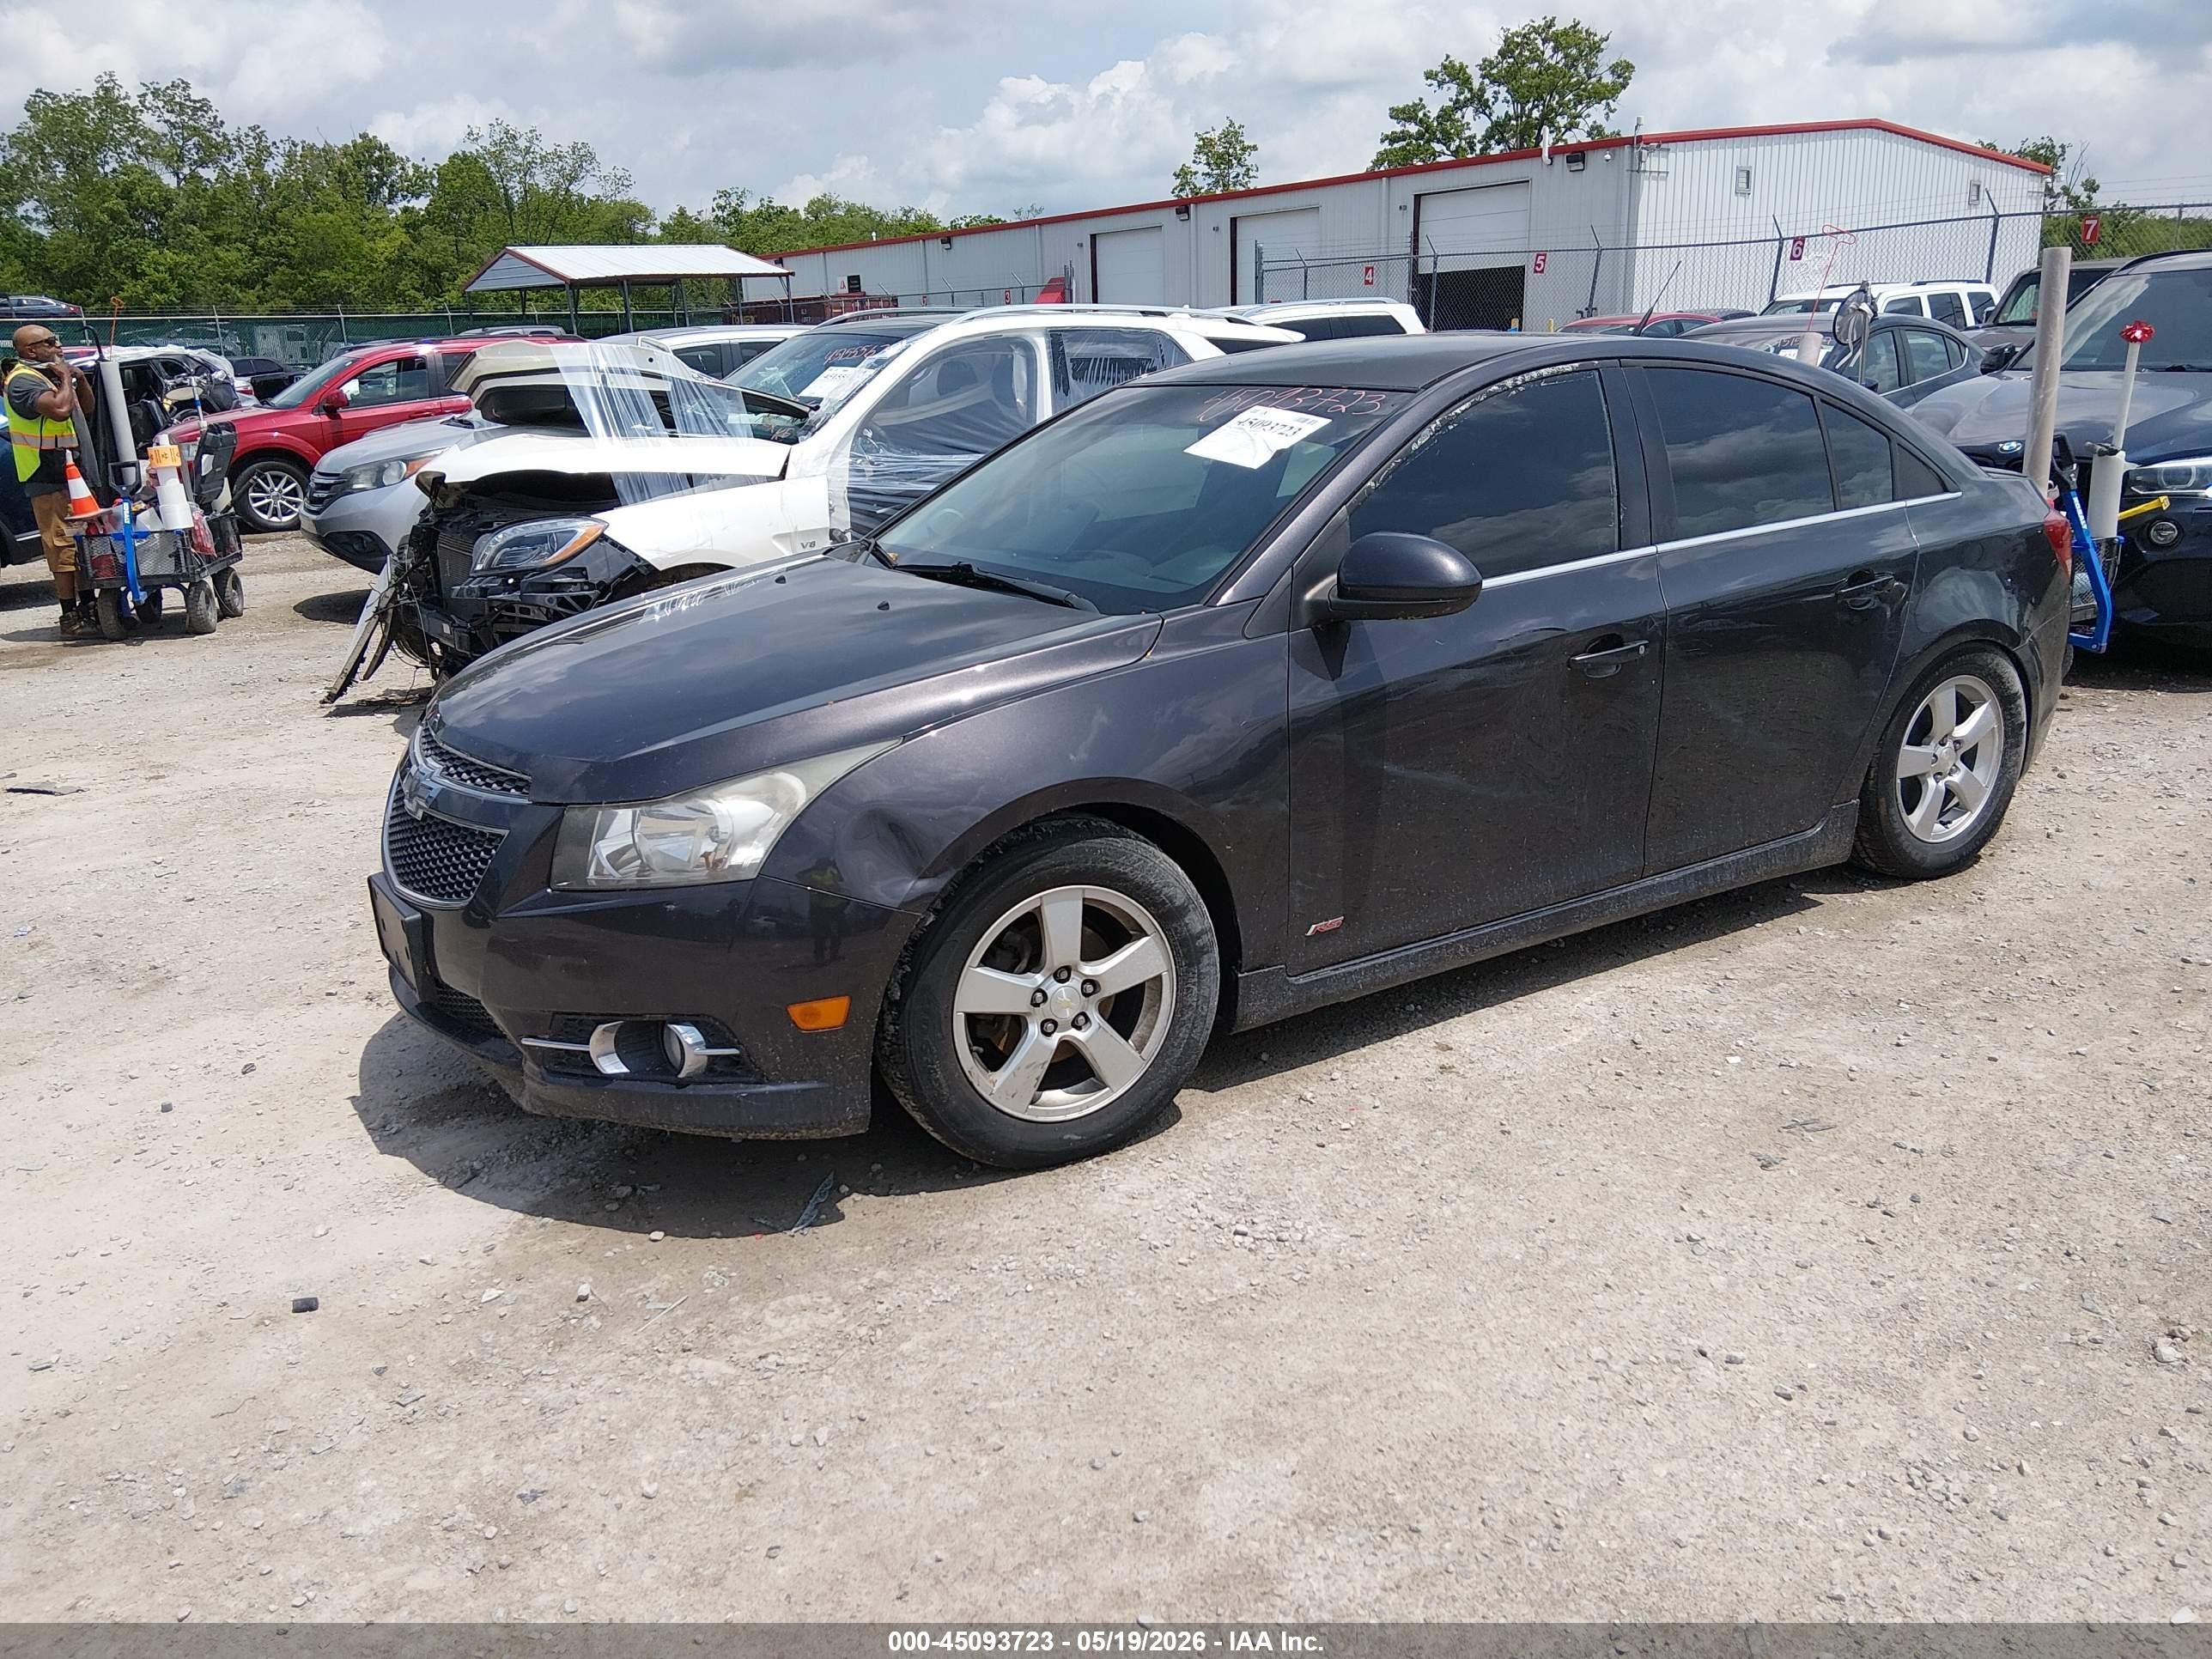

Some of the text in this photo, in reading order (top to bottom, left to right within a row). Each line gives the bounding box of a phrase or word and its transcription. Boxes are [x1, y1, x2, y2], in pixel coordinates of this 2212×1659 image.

[2085, 219, 2098, 240] 7
[1792, 240, 1803, 258] 6
[1534, 255, 1546, 271] 5
[1364, 268, 1373, 283] 4
[1005, 291, 1010, 303] 3
[1196, 386, 1386, 422] 45093723
